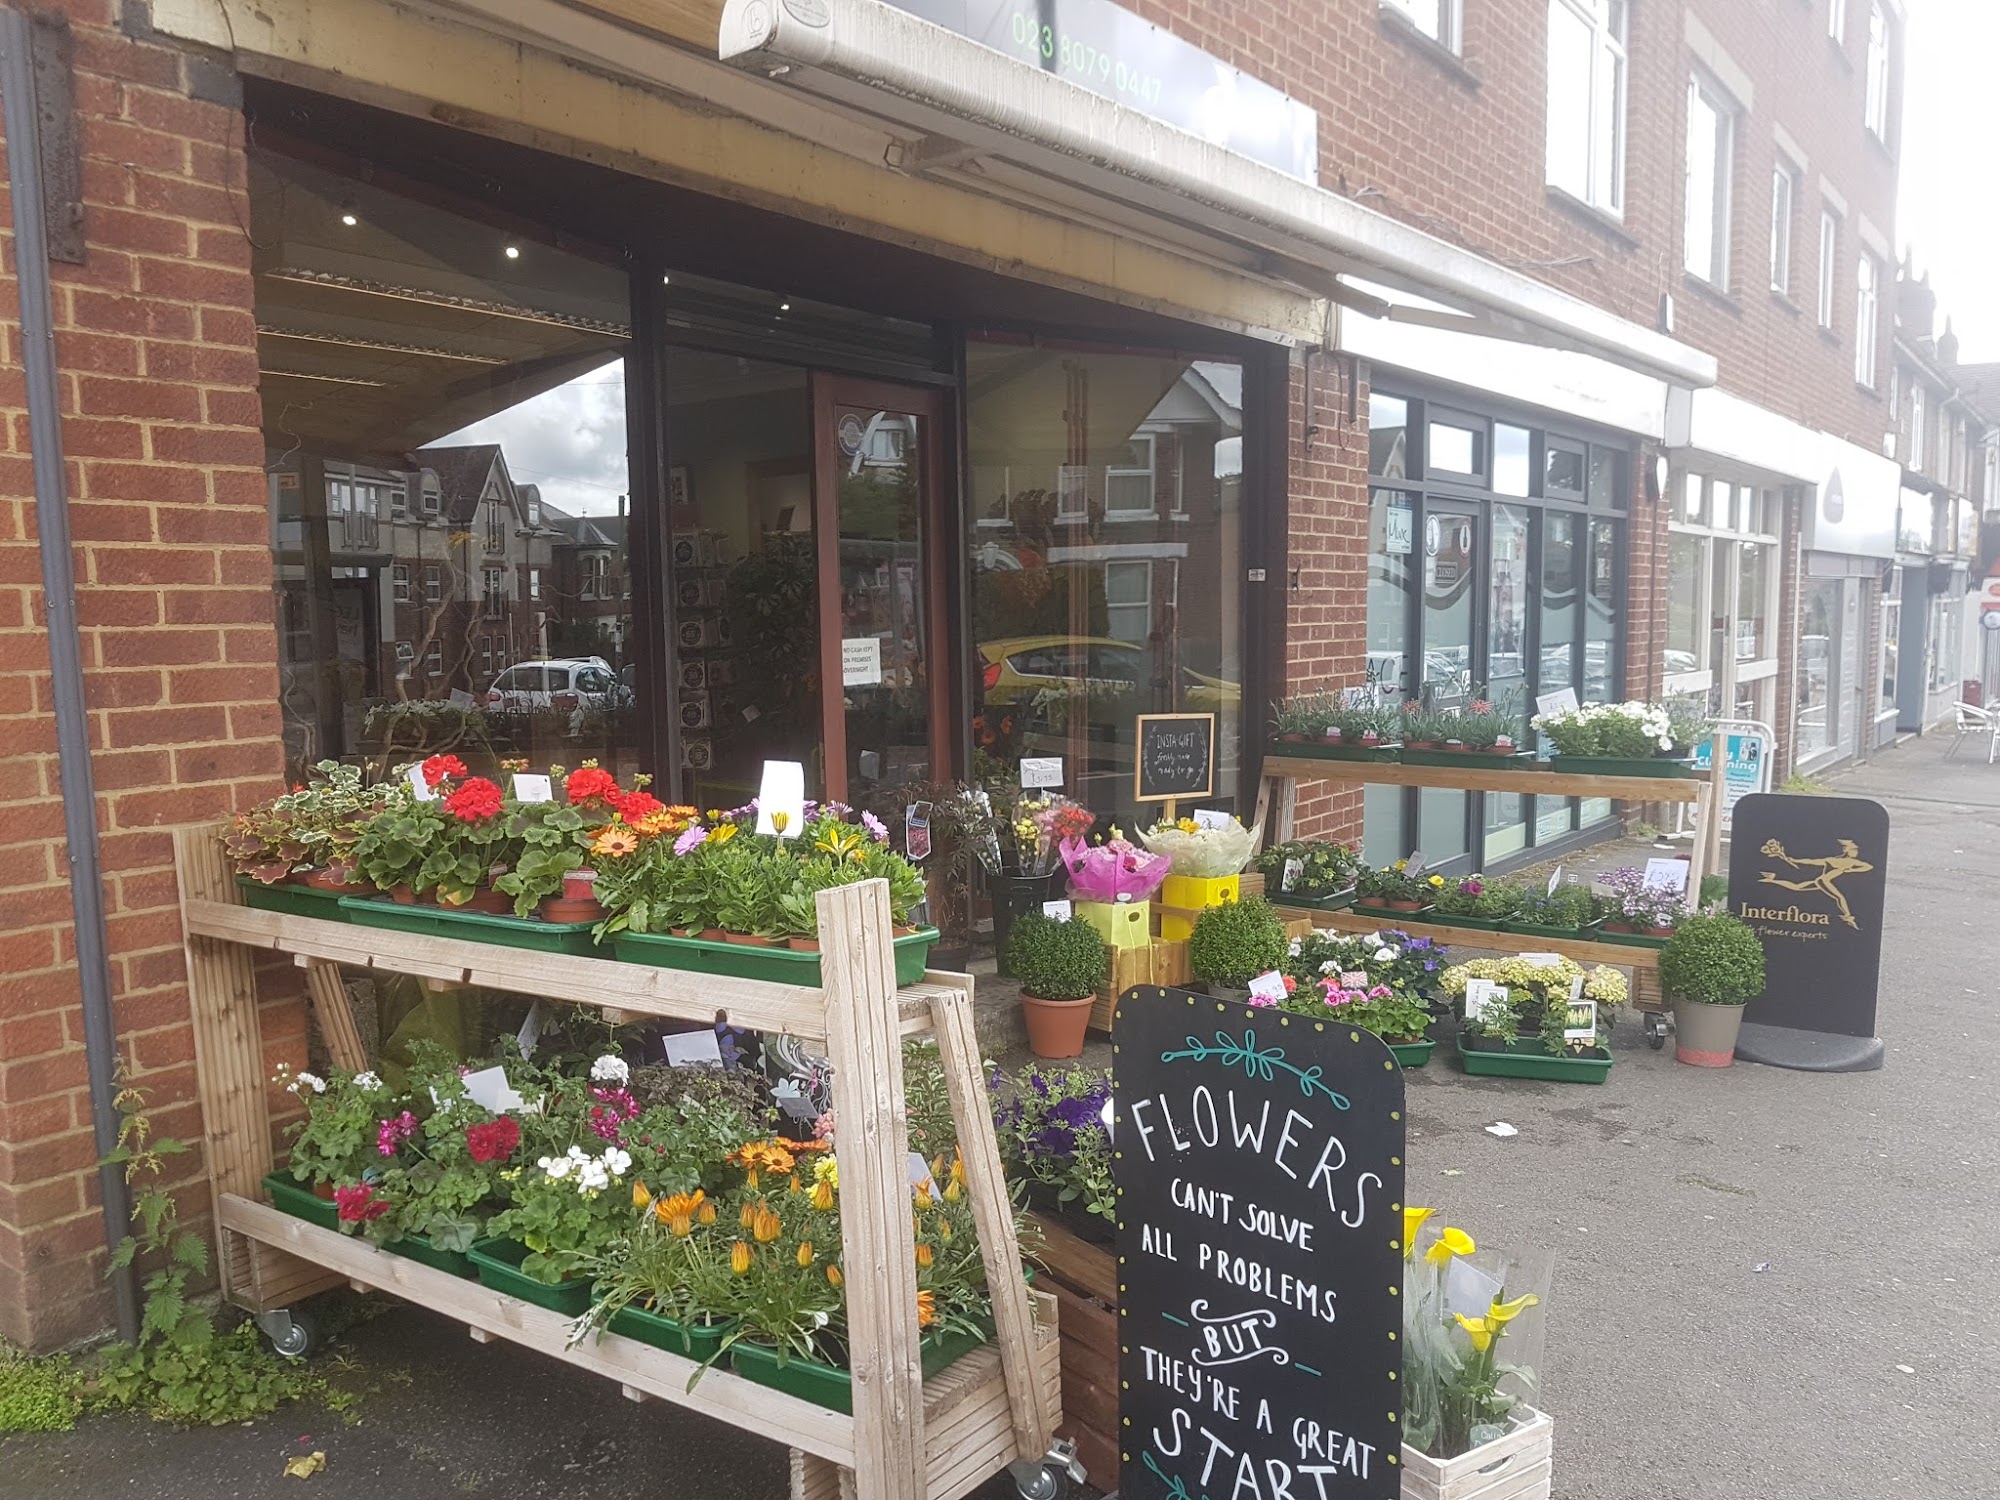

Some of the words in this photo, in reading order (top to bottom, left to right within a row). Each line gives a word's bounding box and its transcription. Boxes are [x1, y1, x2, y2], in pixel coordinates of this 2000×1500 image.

[1012, 12, 1054, 58] 023
[1060, 35, 1110, 82] 8079
[1115, 61, 1161, 105] 0447
[1697, 755, 1758, 773] Clning
[1740, 902, 1829, 925] Interflora
[1757, 925, 1790, 936] flower
[1791, 930, 1828, 943] experts
[1131, 1085, 1383, 1228] FLOWERS
[1171, 1178, 1234, 1224] CAN'T
[1238, 1203, 1315, 1252] SOLVE
[1142, 1223, 1178, 1262] ALL
[1199, 1243, 1338, 1323] PROBLEMS
[1203, 1318, 1262, 1358] BUT
[1140, 1345, 1241, 1421] THEY'RE
[1256, 1399, 1273, 1434] A
[1292, 1417, 1377, 1479] GREAT
[1153, 1408, 1338, 1500] START
